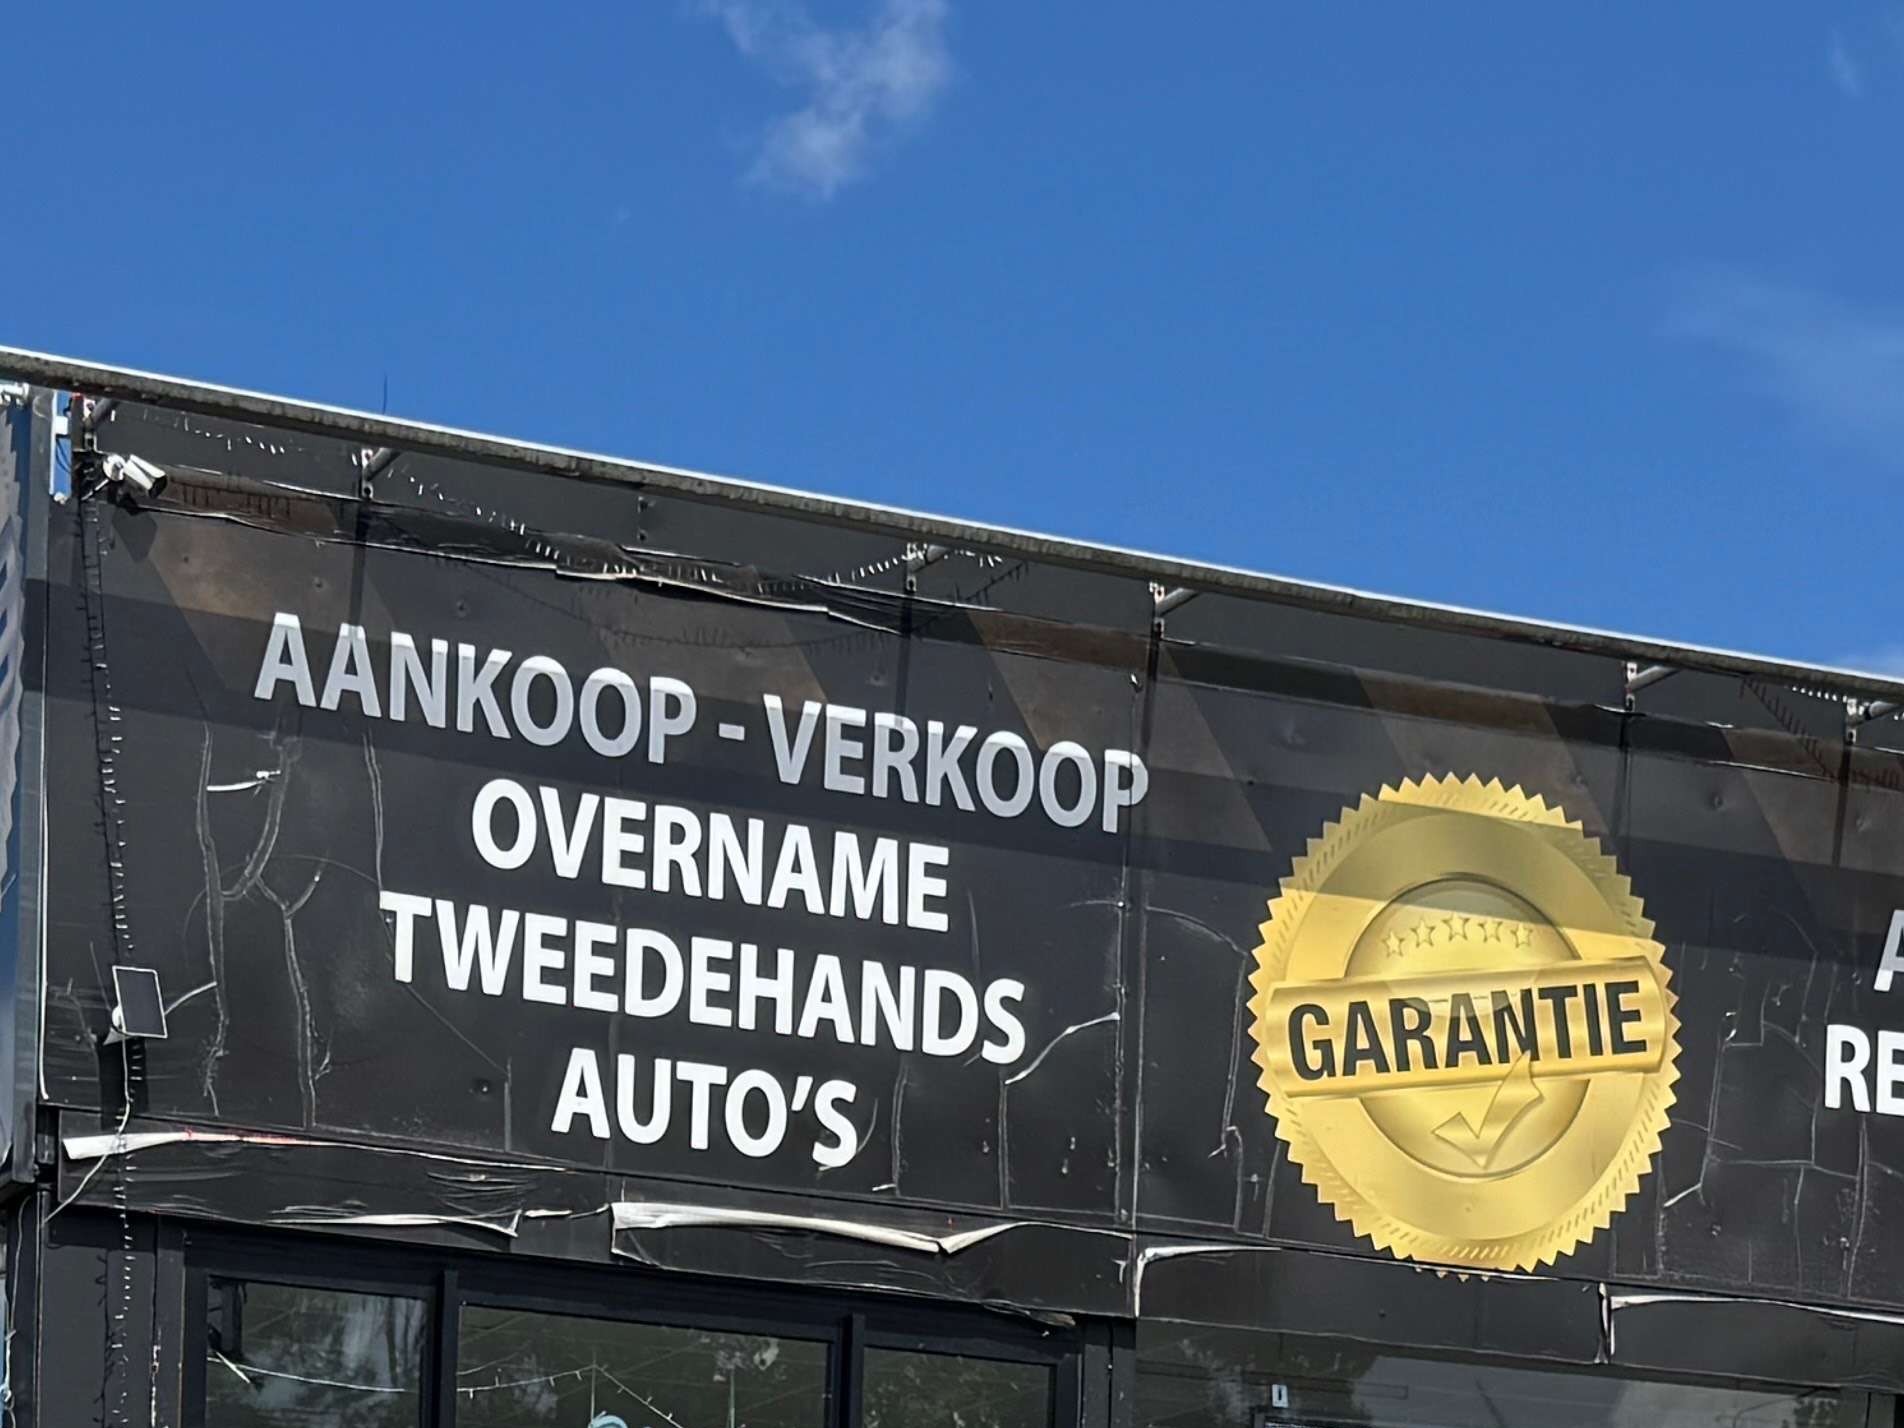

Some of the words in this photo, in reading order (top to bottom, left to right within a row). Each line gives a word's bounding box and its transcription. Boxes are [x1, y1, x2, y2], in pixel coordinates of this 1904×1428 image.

[254, 612, 698, 765] AANKOOP
[764, 694, 1150, 834] VERKOOP
[472, 778, 951, 934] OVERNAME
[379, 891, 1026, 1066] TWEEDEHANDS
[1287, 980, 1648, 1081] GARANTIE
